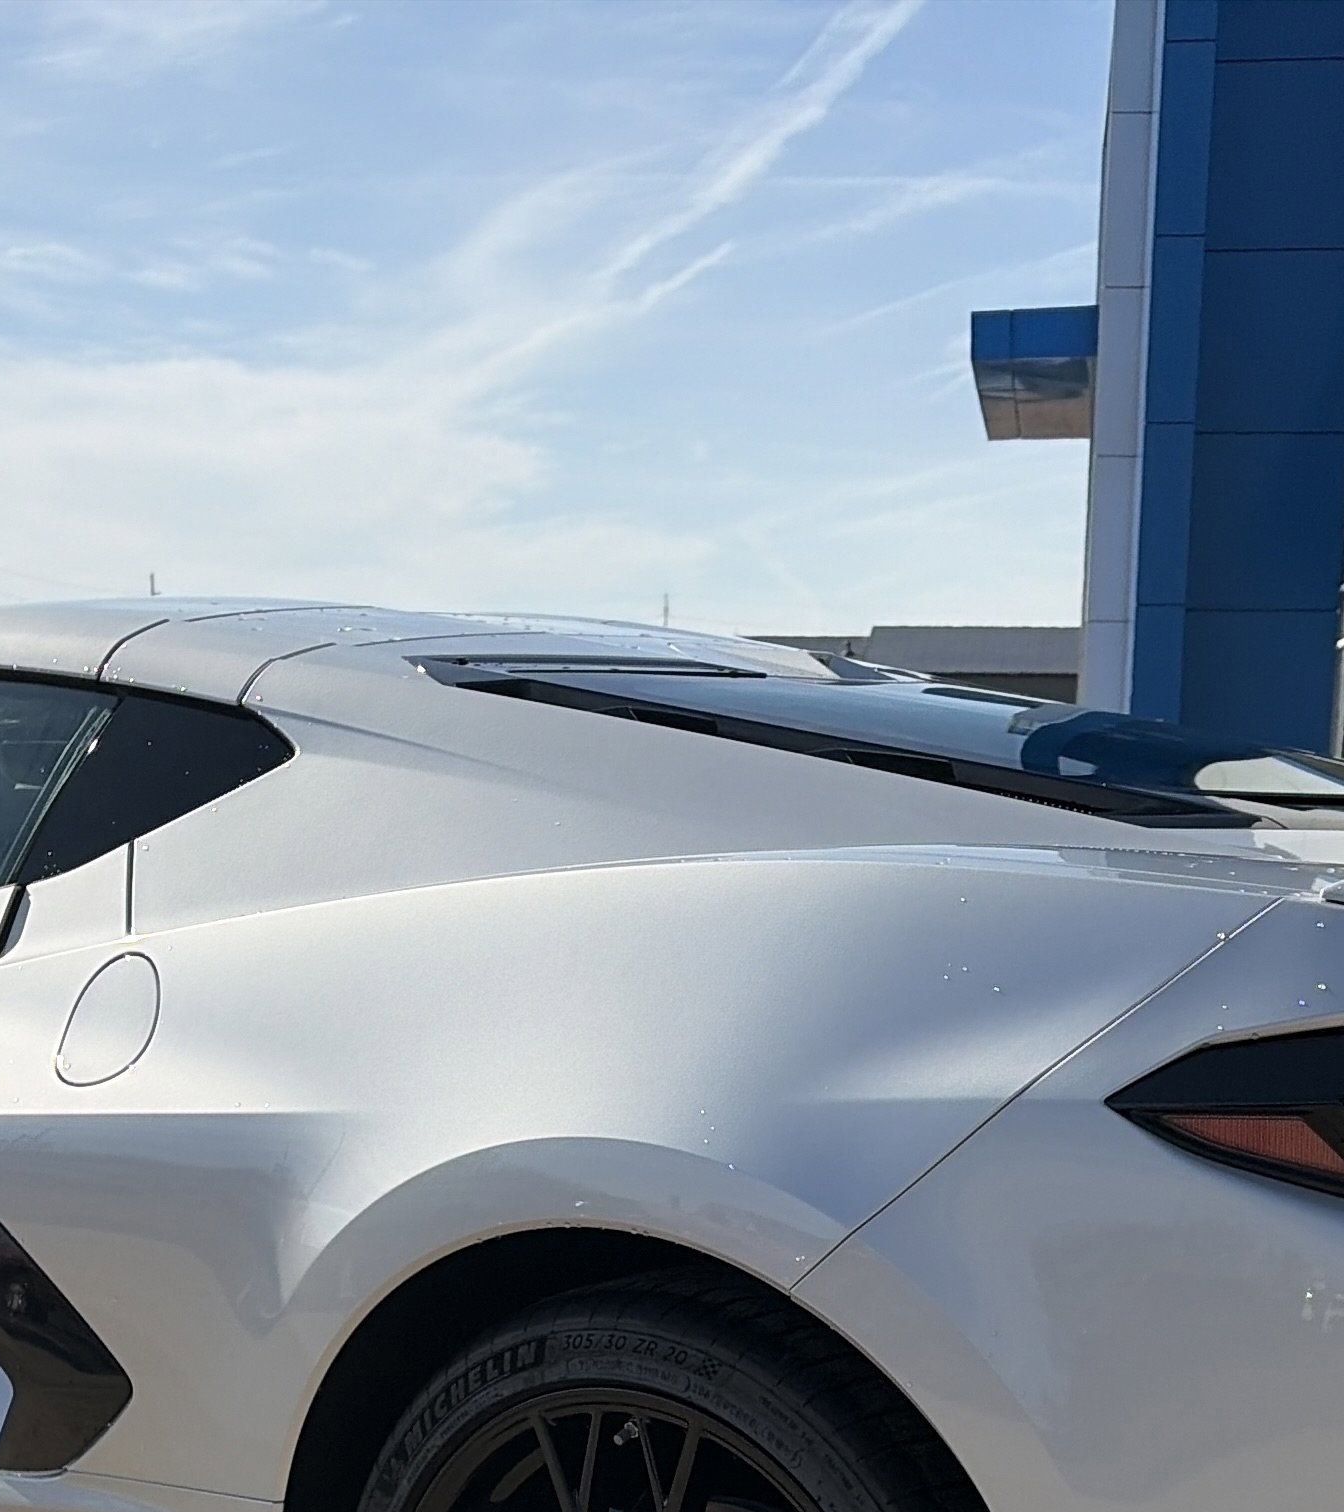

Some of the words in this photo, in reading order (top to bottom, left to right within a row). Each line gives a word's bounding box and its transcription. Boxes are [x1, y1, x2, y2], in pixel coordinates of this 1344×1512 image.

[563, 1333, 628, 1351] 305/30
[631, 1338, 658, 1357] ZR
[663, 1346, 688, 1365] 20
[404, 1341, 537, 1457] MICHELIN
